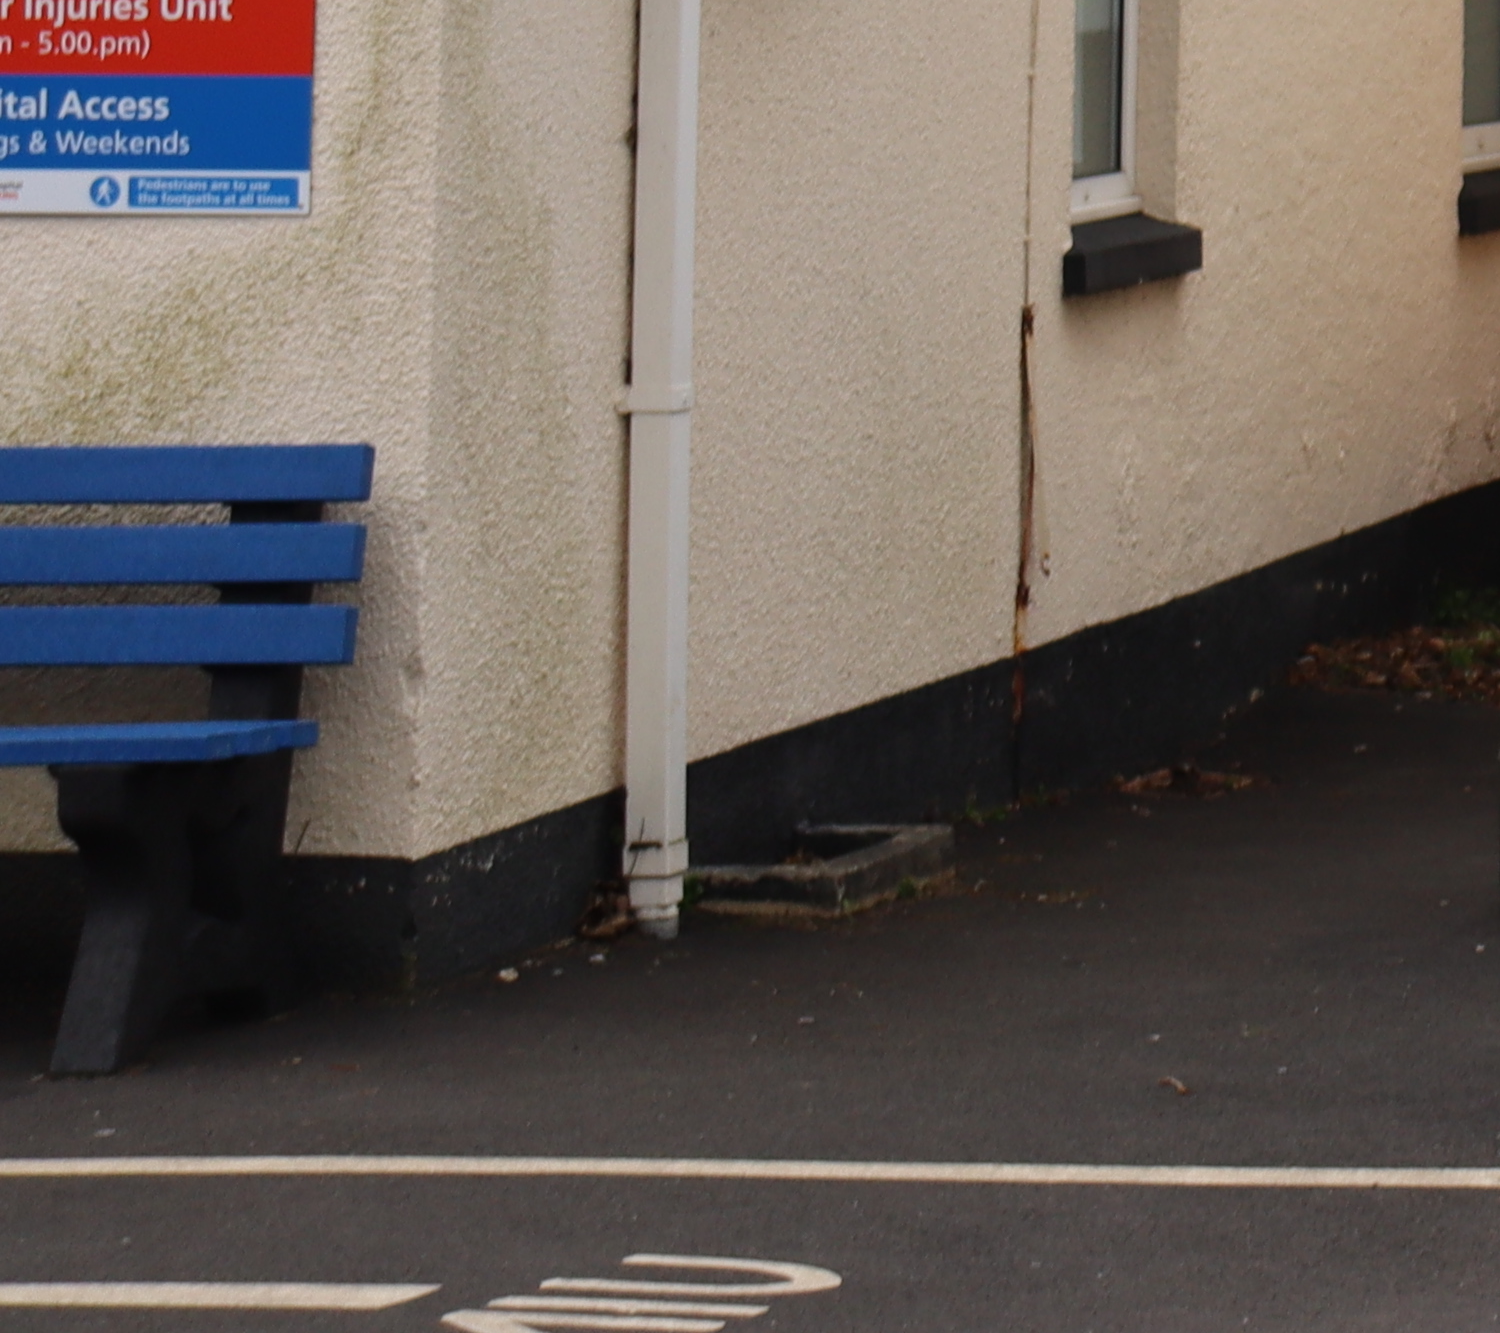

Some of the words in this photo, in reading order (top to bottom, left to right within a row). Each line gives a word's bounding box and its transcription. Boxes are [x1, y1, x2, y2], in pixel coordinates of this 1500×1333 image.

[38, 30, 151, 61] 5.00.pm)
[57, 91, 170, 120] Access
[29, 131, 47, 155] &
[56, 130, 190, 156] Weekends
[138, 179, 207, 191] Pedestrians
[210, 181, 229, 191] are
[232, 180, 246, 191] to
[249, 182, 271, 191] use
[138, 193, 156, 206] the
[161, 193, 219, 208] footpaths
[223, 194, 236, 206] at
[239, 193, 254, 206] all
[257, 193, 291, 207] times
